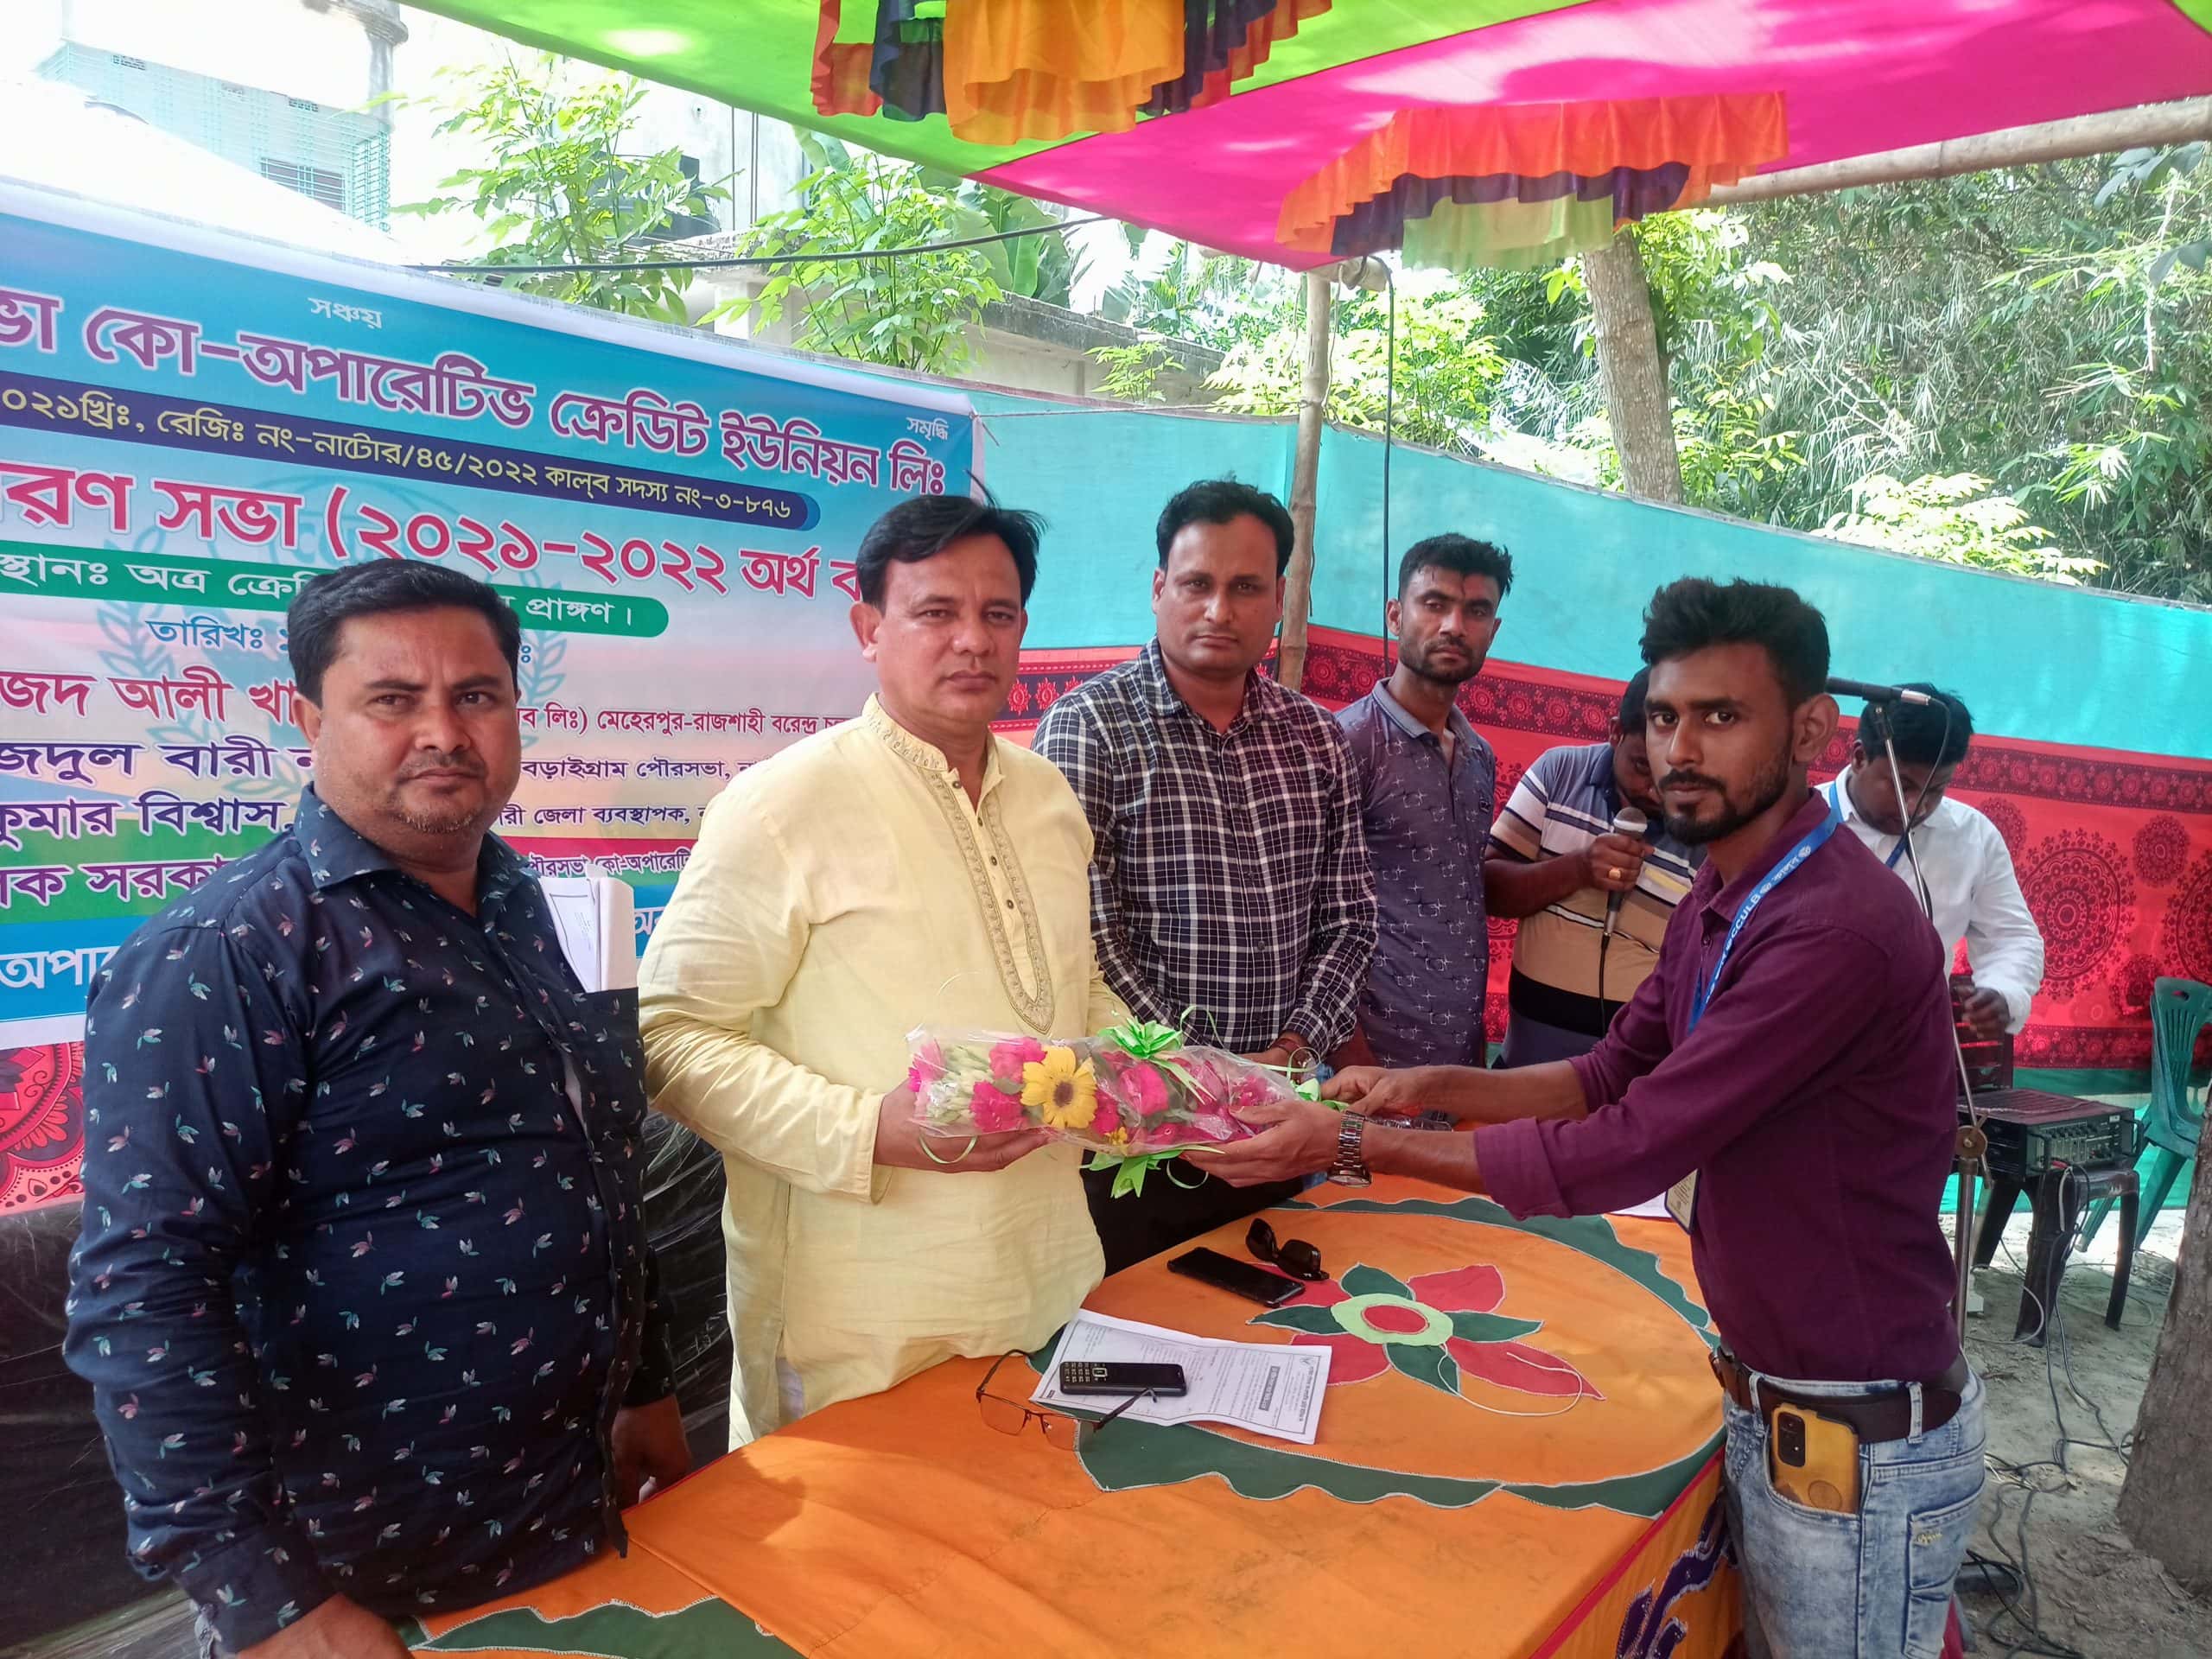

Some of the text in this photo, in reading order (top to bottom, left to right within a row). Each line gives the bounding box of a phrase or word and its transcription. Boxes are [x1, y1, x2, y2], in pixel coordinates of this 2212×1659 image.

[309, 296, 383, 329] সঞ্চয়
[86, 308, 534, 426] কো-অপারেটিভ
[551, 391, 709, 454] ক্রেডিট
[721, 411, 879, 485] ইউনিয়ন
[906, 417, 949, 441] সমৃদ্ধি
[616, 477, 669, 502] সদস্য
[154, 480, 302, 548] সভা
[740, 548, 820, 598] অর্থ
[124, 563, 212, 594] অত্র
[525, 596, 615, 625] প্রাঙ্গণ
[107, 666, 234, 722] আলী
[771, 715, 819, 734] বরেন্দ্র
[157, 735, 278, 777] বারী
[520, 757, 629, 780] বড়াইগ্রাম
[534, 807, 588, 824] জেলা
[1731, 893, 1761, 939] CCULB
